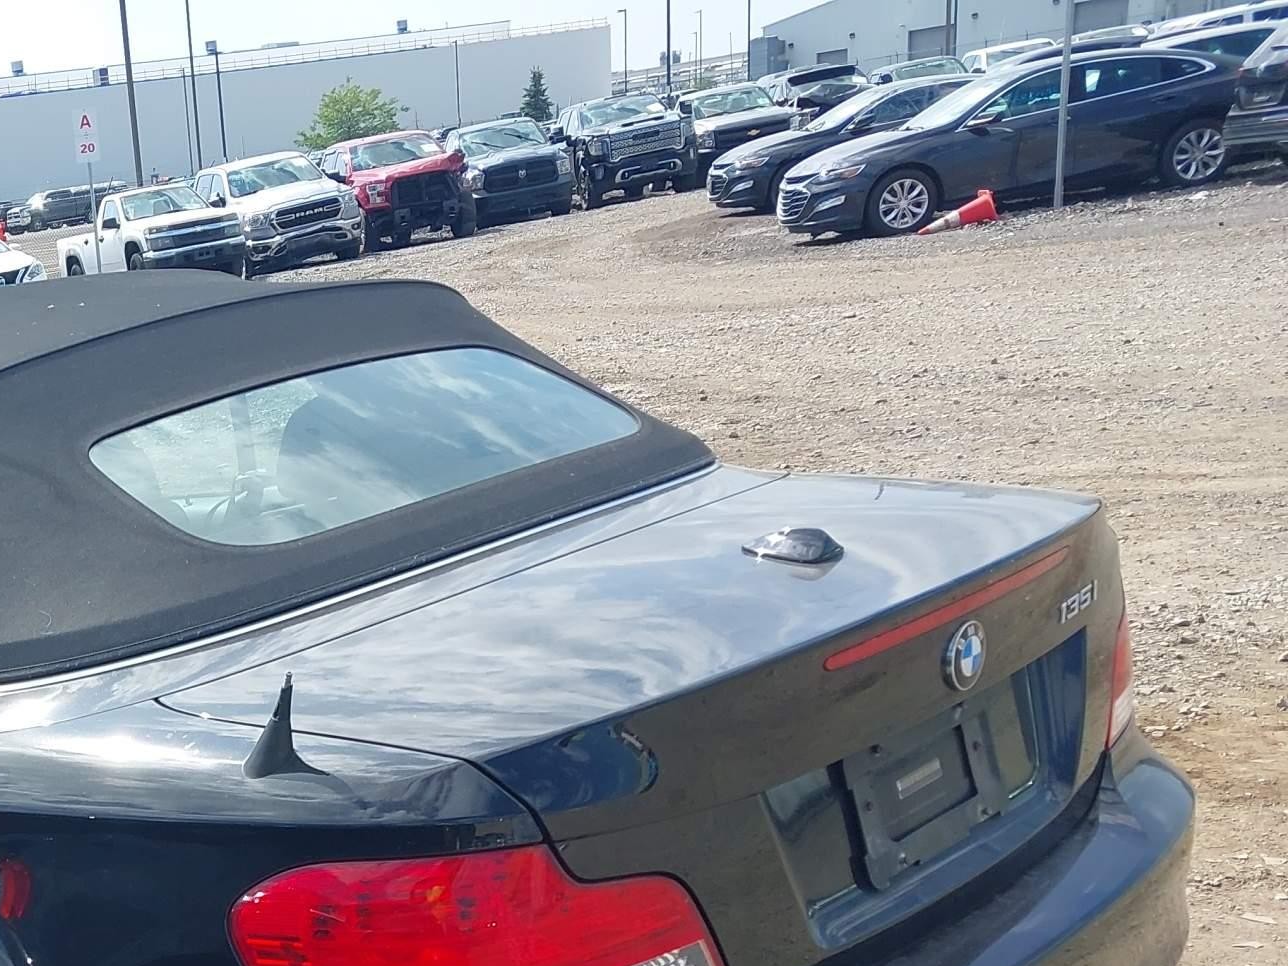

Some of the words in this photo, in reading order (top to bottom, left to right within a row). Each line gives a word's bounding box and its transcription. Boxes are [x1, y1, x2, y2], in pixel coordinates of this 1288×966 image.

[79, 114, 92, 130] A
[80, 143, 96, 154] 20
[295, 207, 324, 218] RAM
